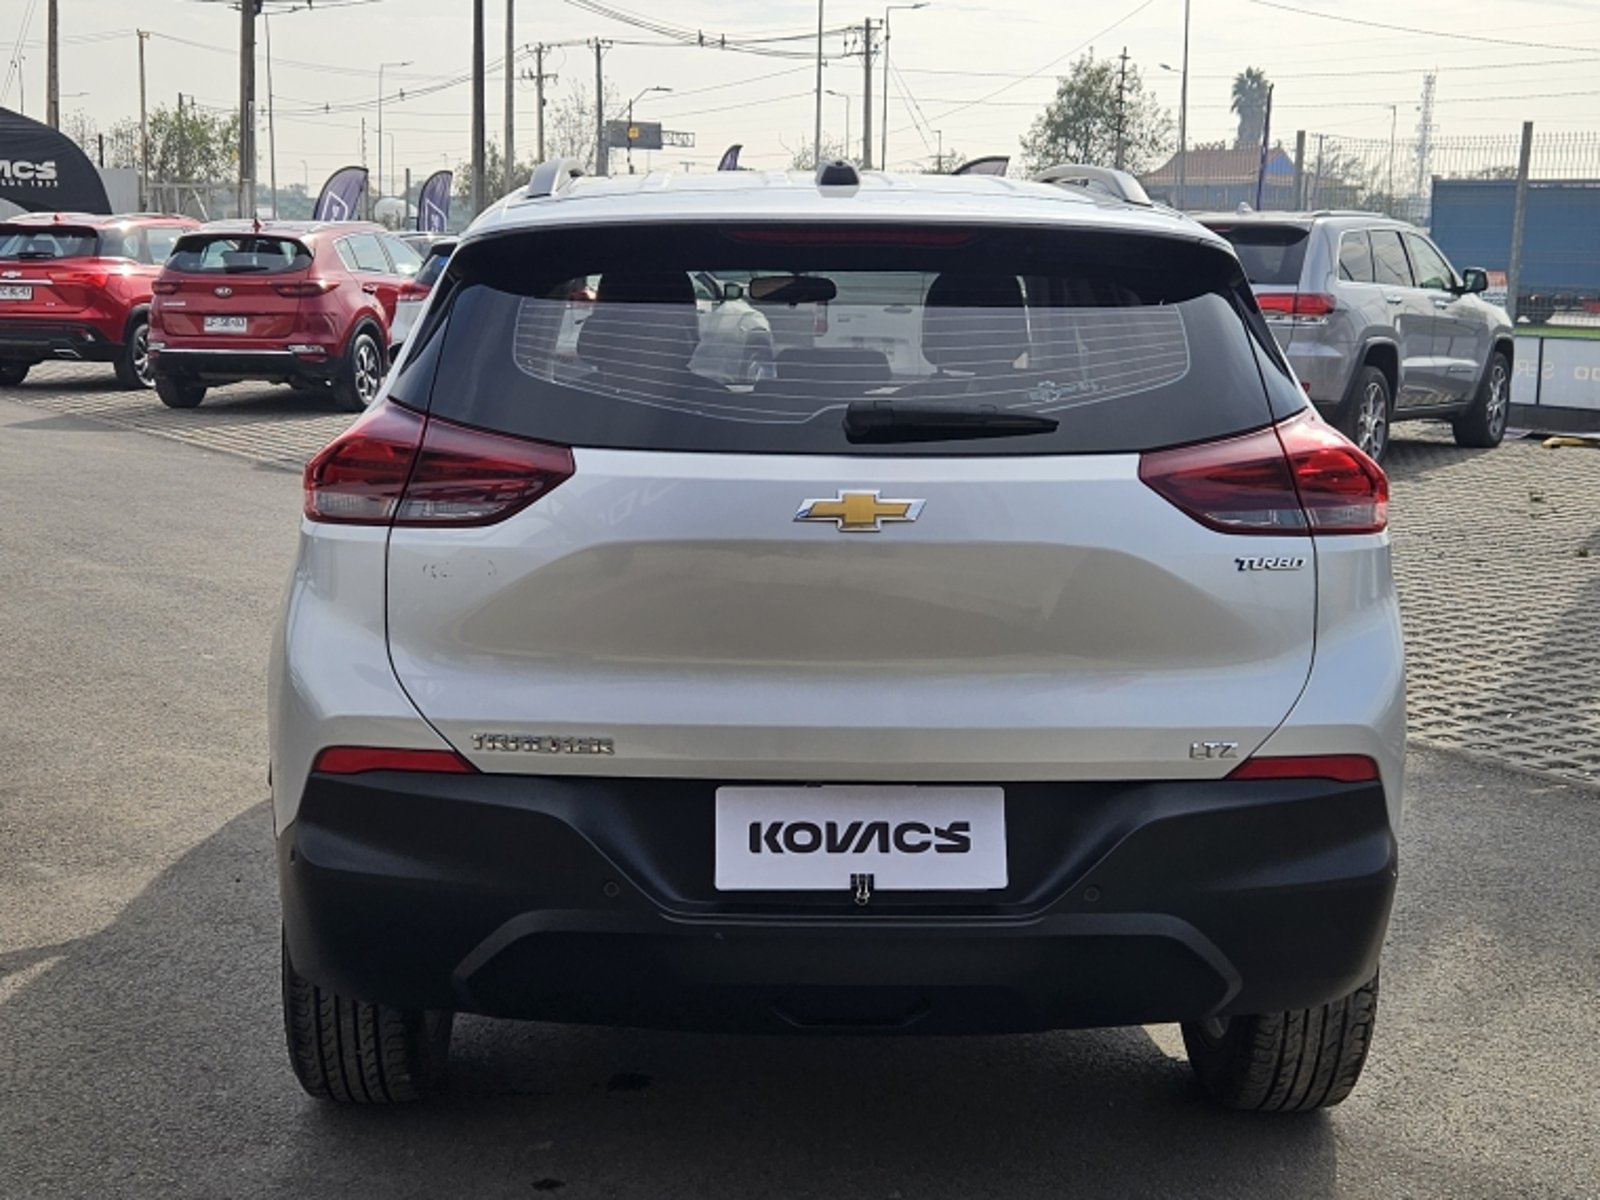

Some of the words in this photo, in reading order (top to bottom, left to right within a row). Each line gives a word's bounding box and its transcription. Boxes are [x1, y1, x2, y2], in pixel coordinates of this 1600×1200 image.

[1234, 557, 1306, 572] TURBO
[472, 732, 616, 756] TRACKER
[1189, 741, 1239, 760] LTZ
[749, 821, 971, 854] KOVACS
